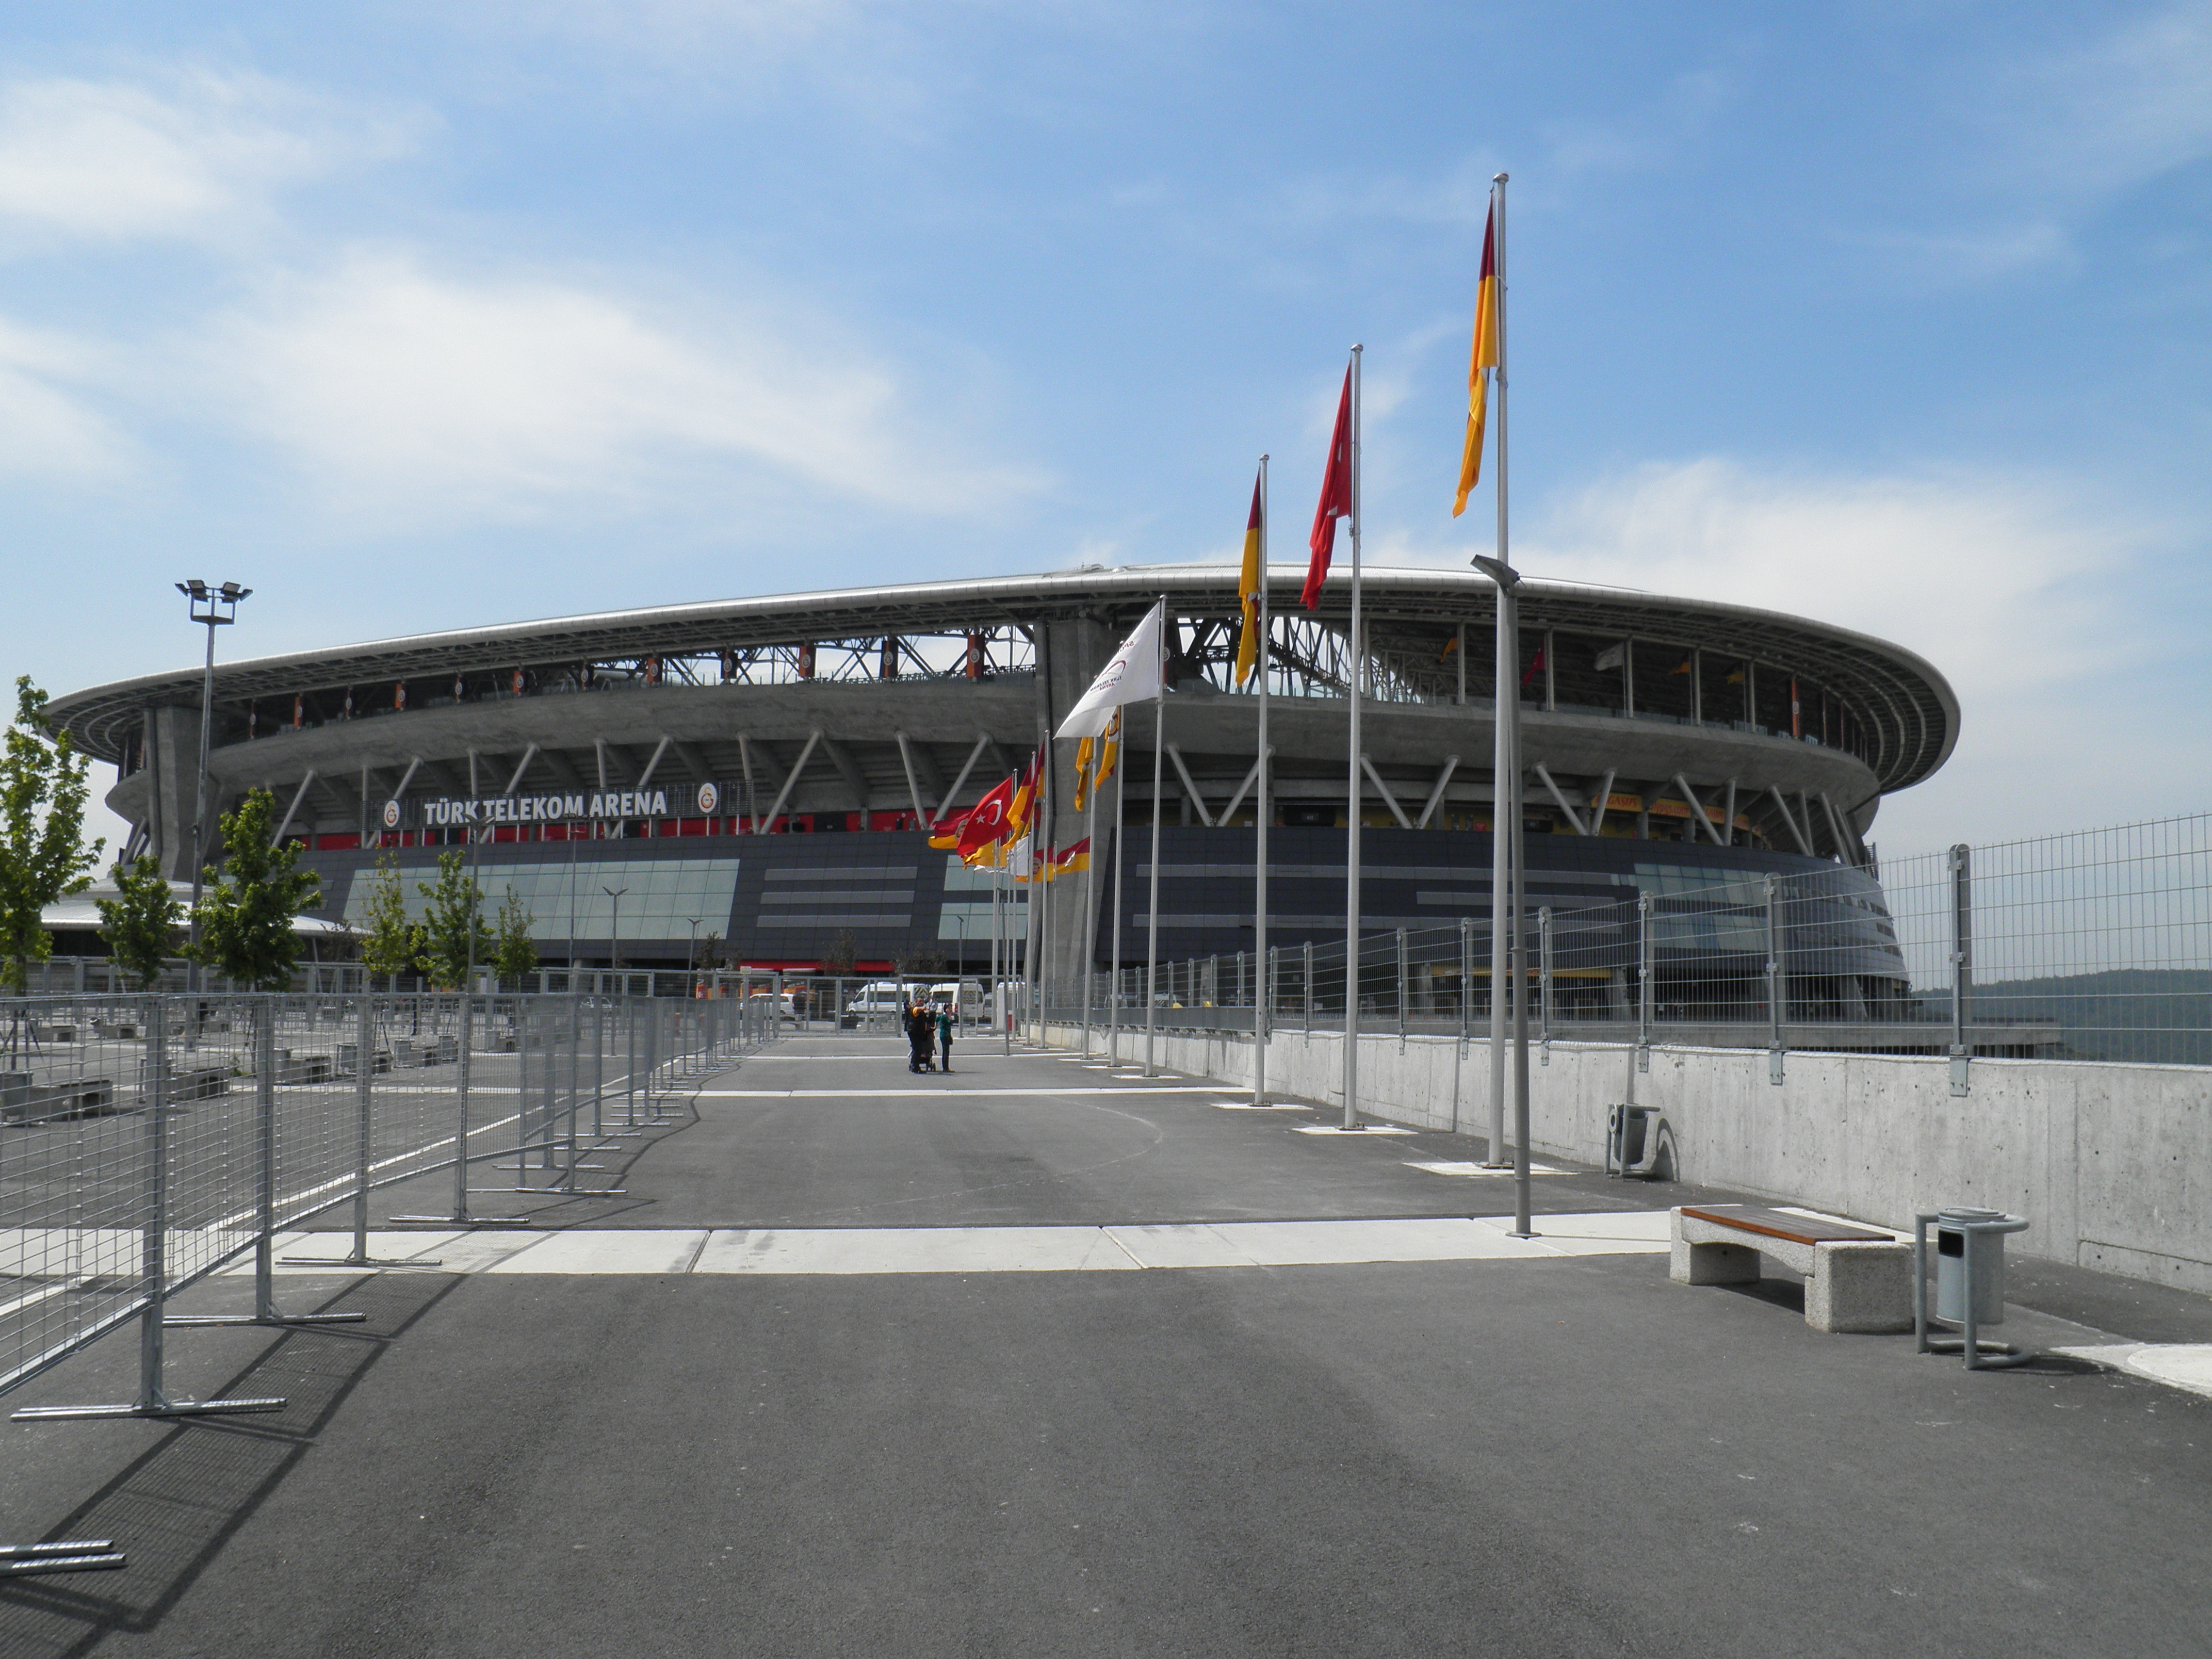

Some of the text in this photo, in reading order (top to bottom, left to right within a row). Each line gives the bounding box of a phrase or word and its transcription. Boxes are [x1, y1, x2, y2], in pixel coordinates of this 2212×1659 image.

[425, 791, 667, 825] TÜRK TELEKOM ARENA
